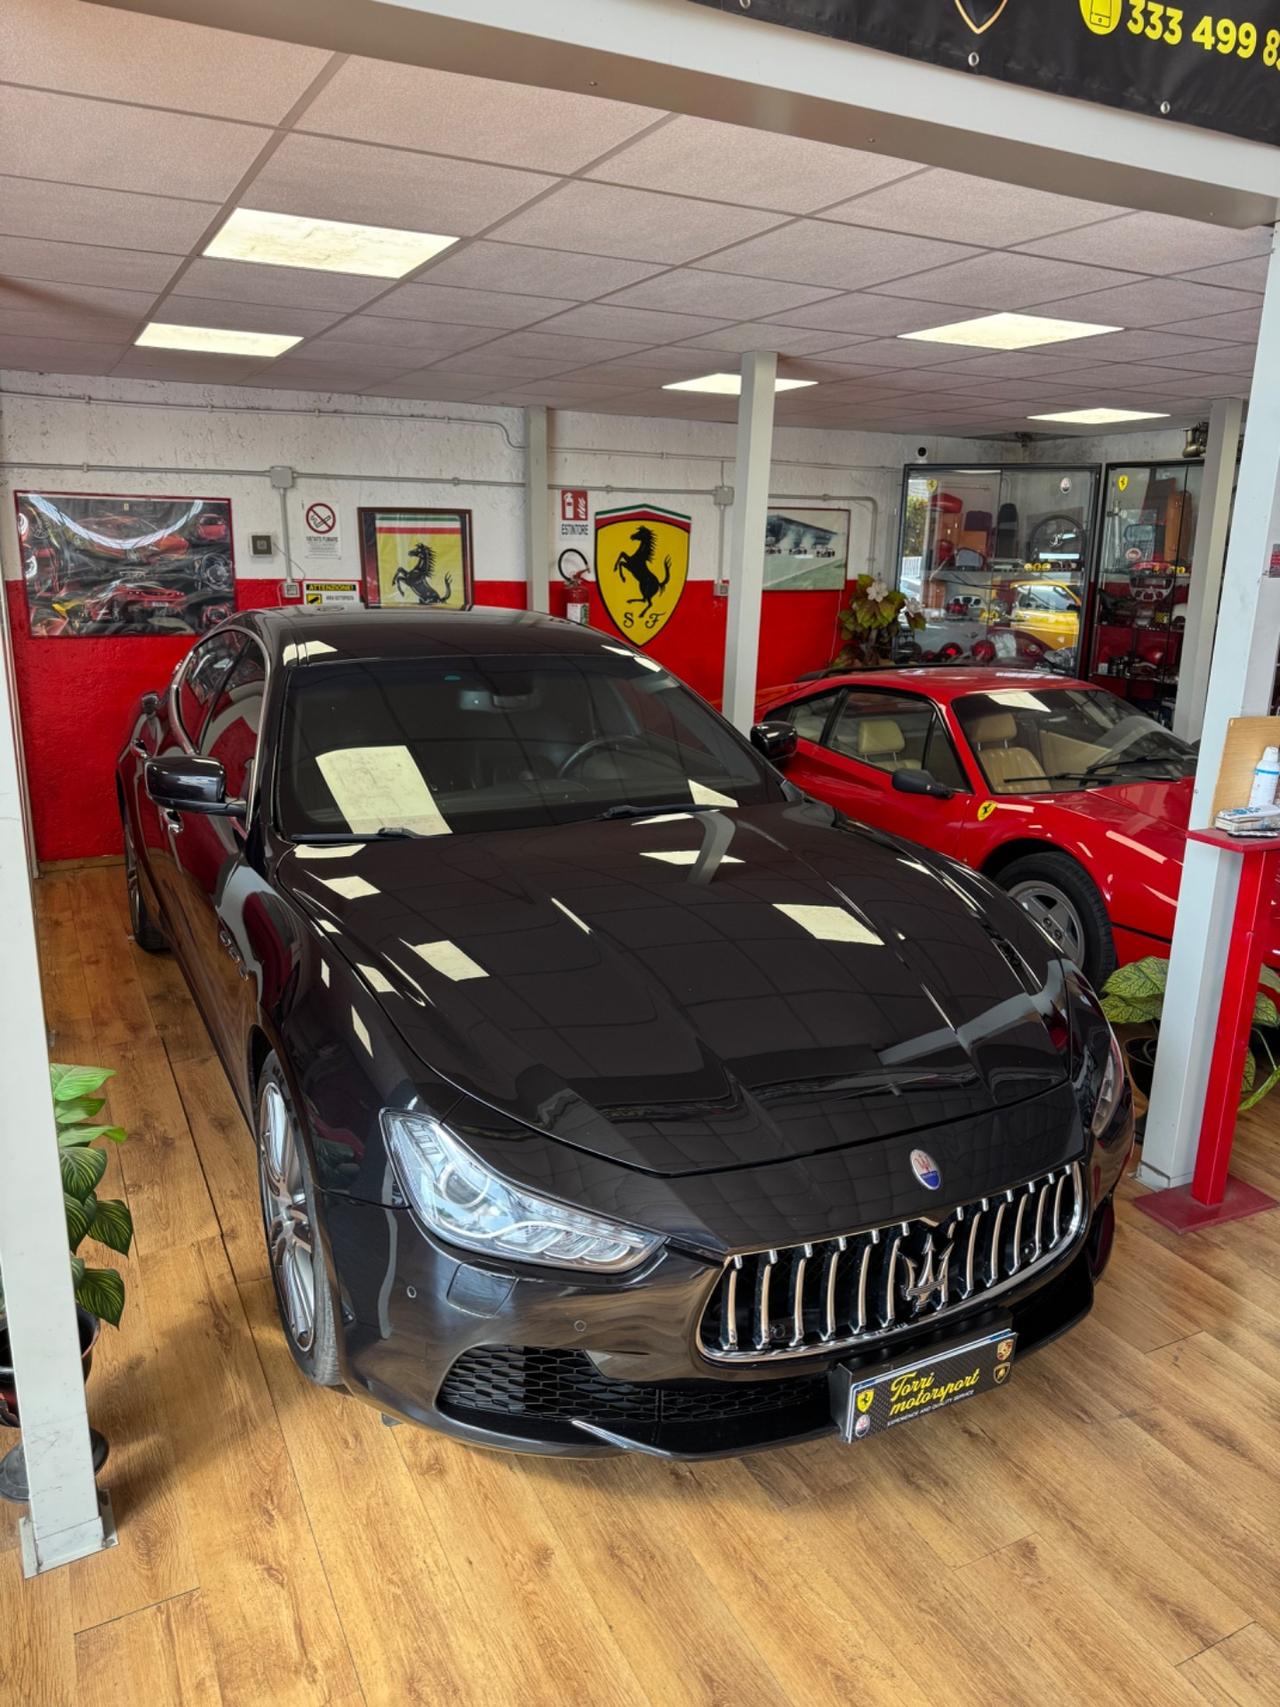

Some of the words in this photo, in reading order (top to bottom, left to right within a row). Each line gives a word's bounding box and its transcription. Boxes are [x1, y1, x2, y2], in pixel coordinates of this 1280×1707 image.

[1127, 0, 1183, 45] 333
[1191, 15, 1257, 59] 499
[1262, 29, 1280, 71] 8
[561, 524, 589, 535] ESTINTORE
[623, 612, 635, 628] S
[645, 612, 666, 628] F
[889, 1368, 980, 1416] motorsport
[890, 1371, 935, 1401] Torri
